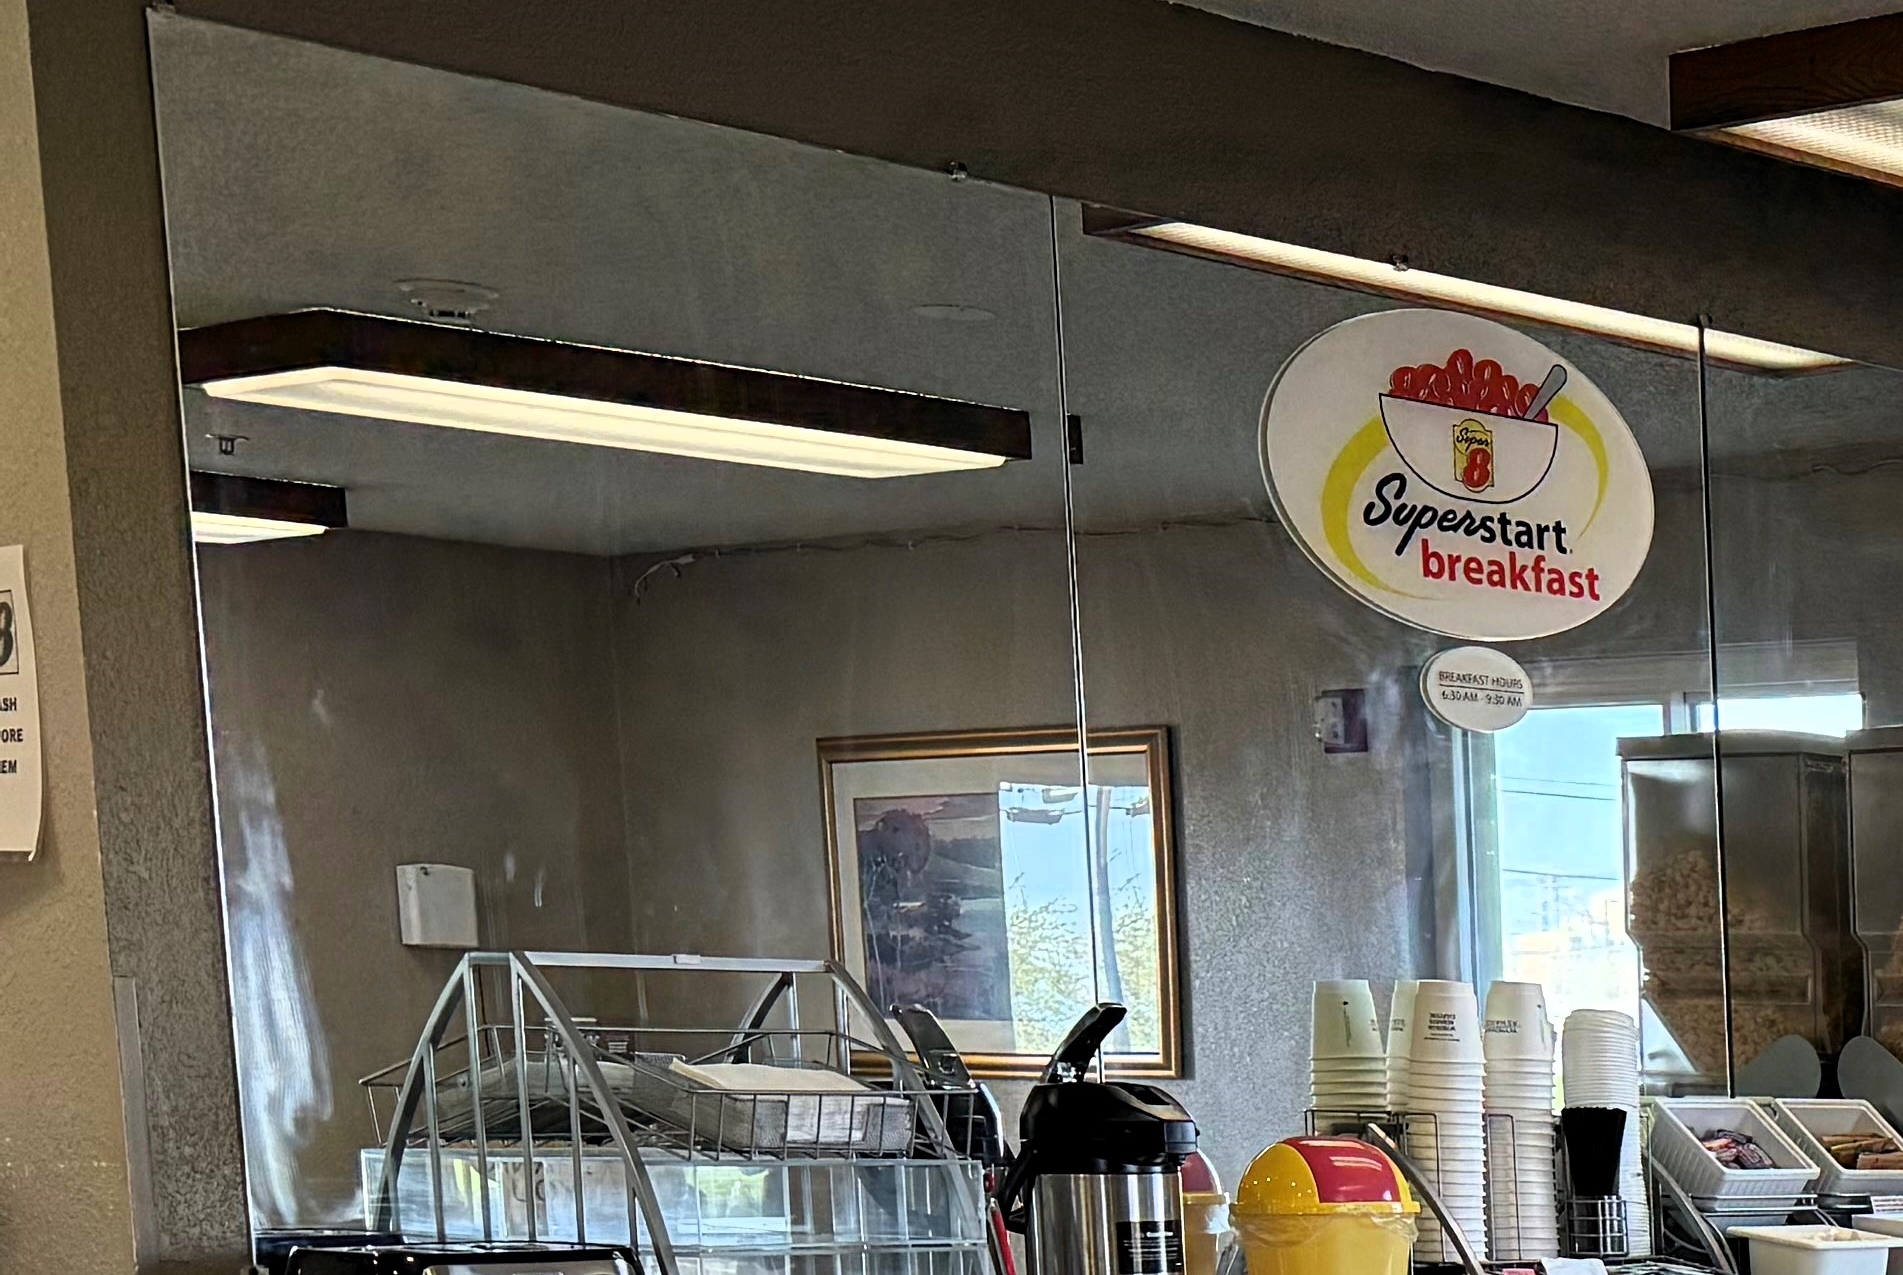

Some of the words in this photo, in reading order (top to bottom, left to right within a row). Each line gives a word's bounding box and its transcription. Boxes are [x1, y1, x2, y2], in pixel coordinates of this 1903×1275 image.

[1456, 427, 1490, 452] Super
[1463, 448, 1491, 488] 8
[1363, 472, 1568, 556] Superstart
[1421, 539, 1601, 601] breakfast
[1438, 671, 1489, 686] BREAKFAST
[1491, 676, 1523, 689] HOURS
[0, 728, 23, 742] ORE
[0, 760, 17, 774] EM
